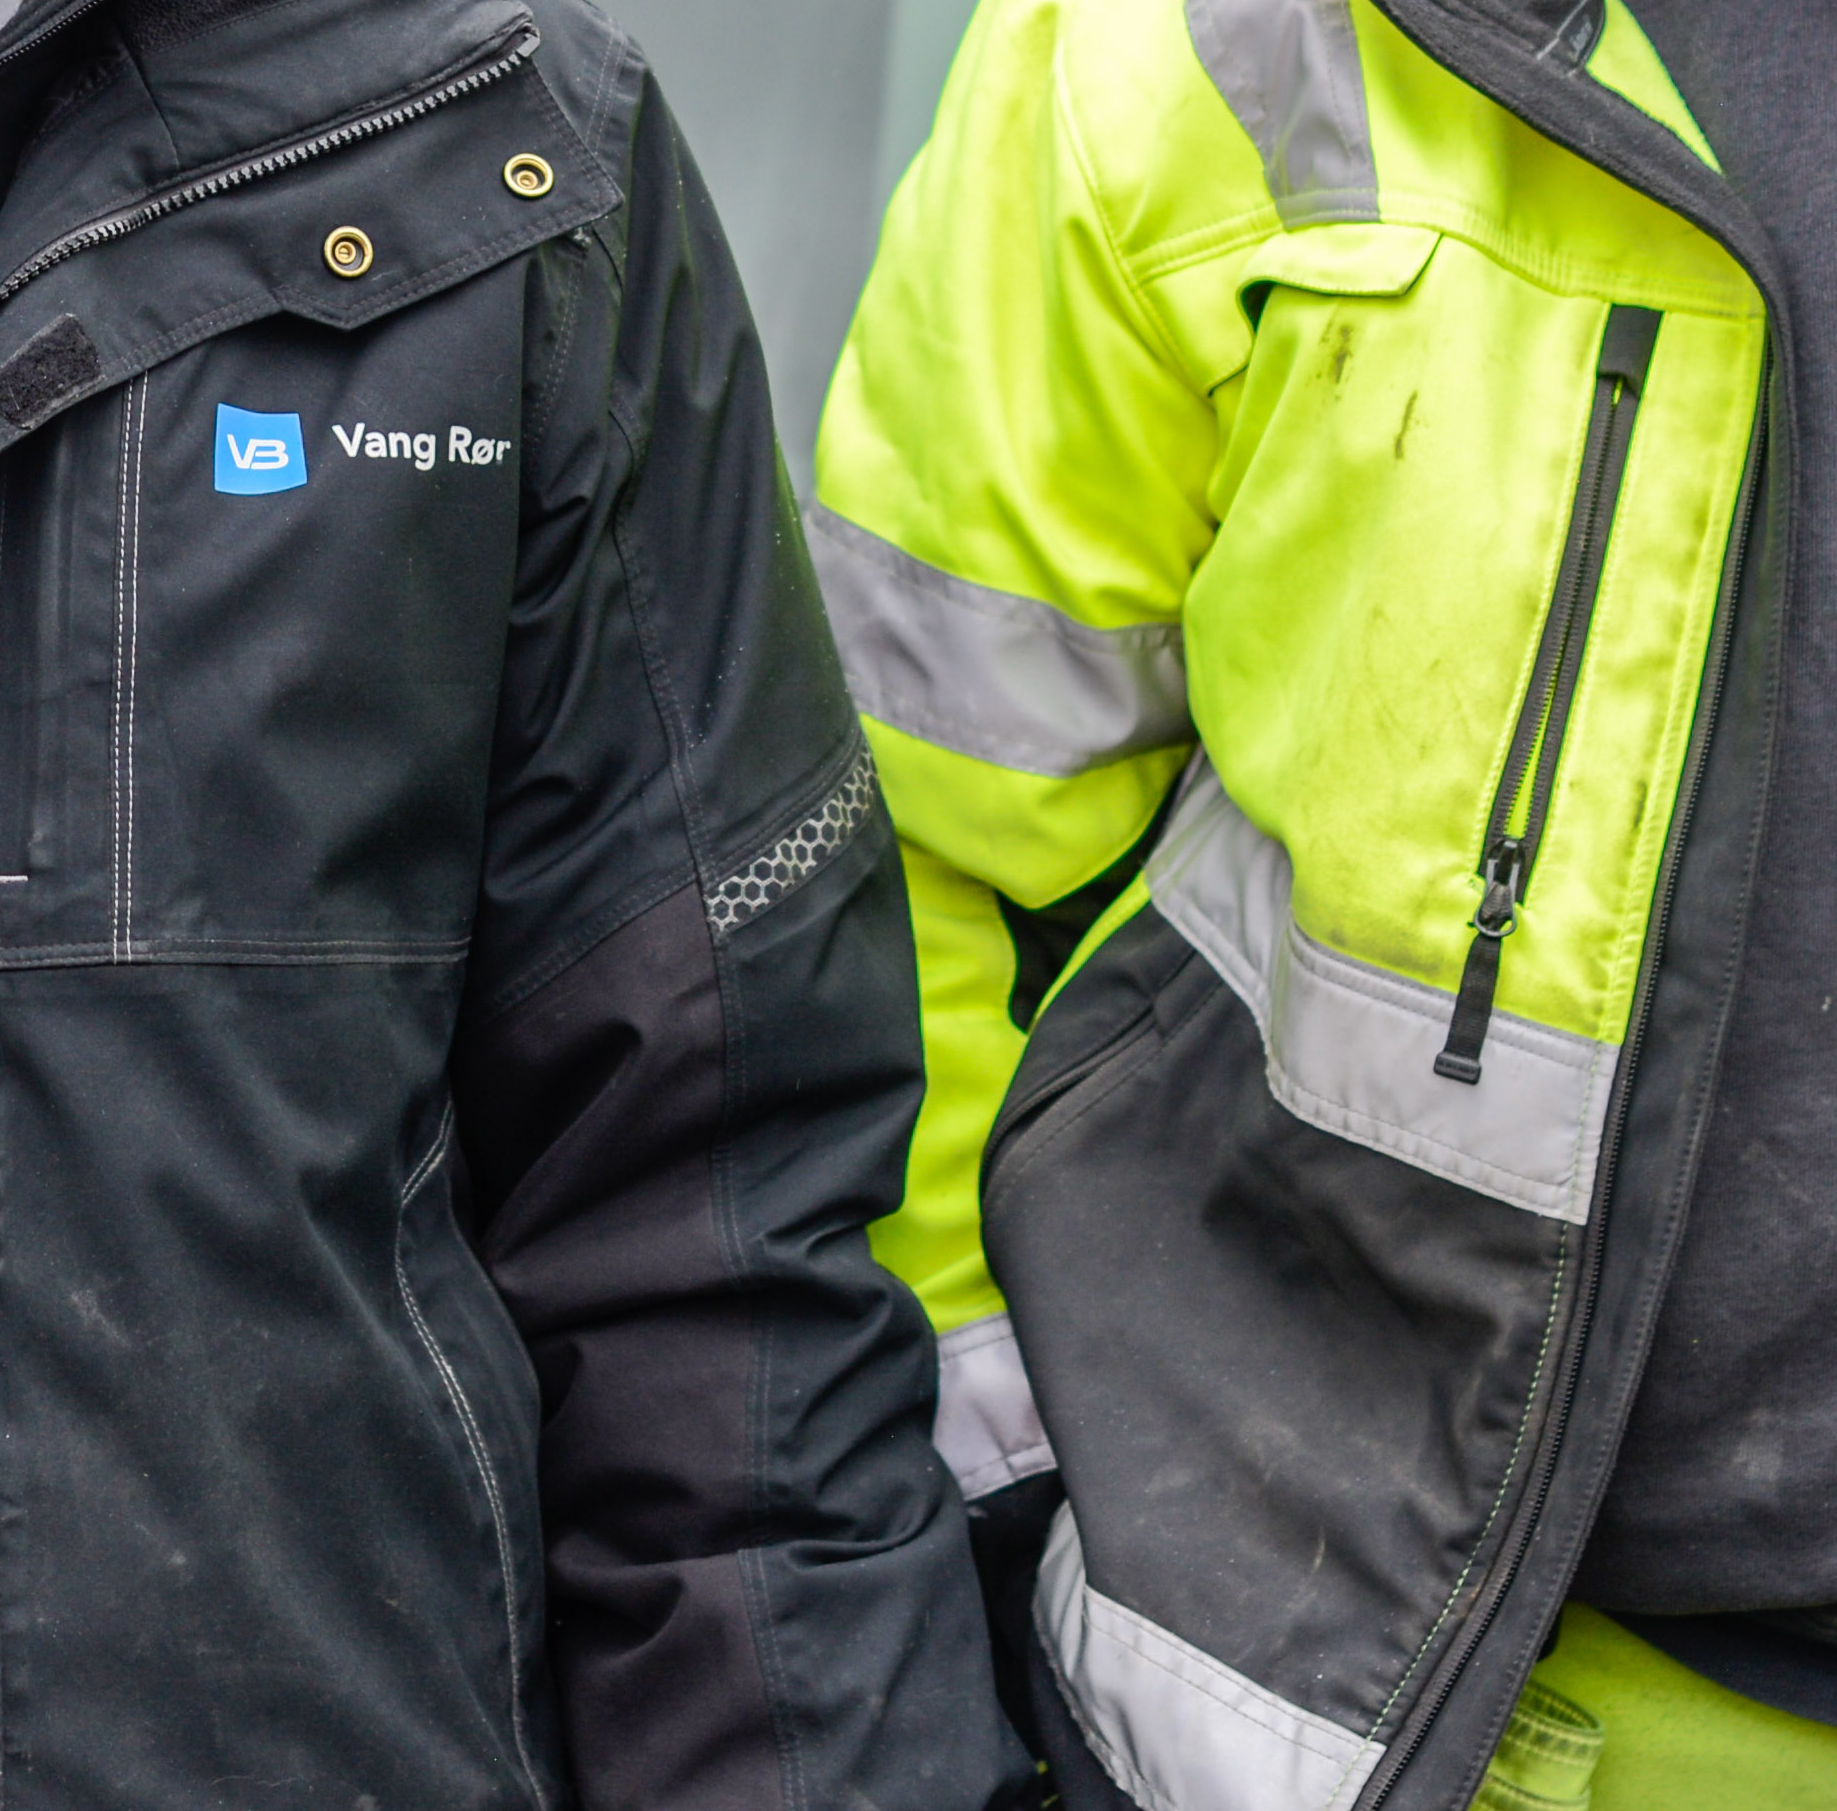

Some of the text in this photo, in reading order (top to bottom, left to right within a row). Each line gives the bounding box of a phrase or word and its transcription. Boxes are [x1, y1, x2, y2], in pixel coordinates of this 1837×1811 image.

[226, 433, 290, 471] VB
[331, 422, 512, 472] Vang Rør
